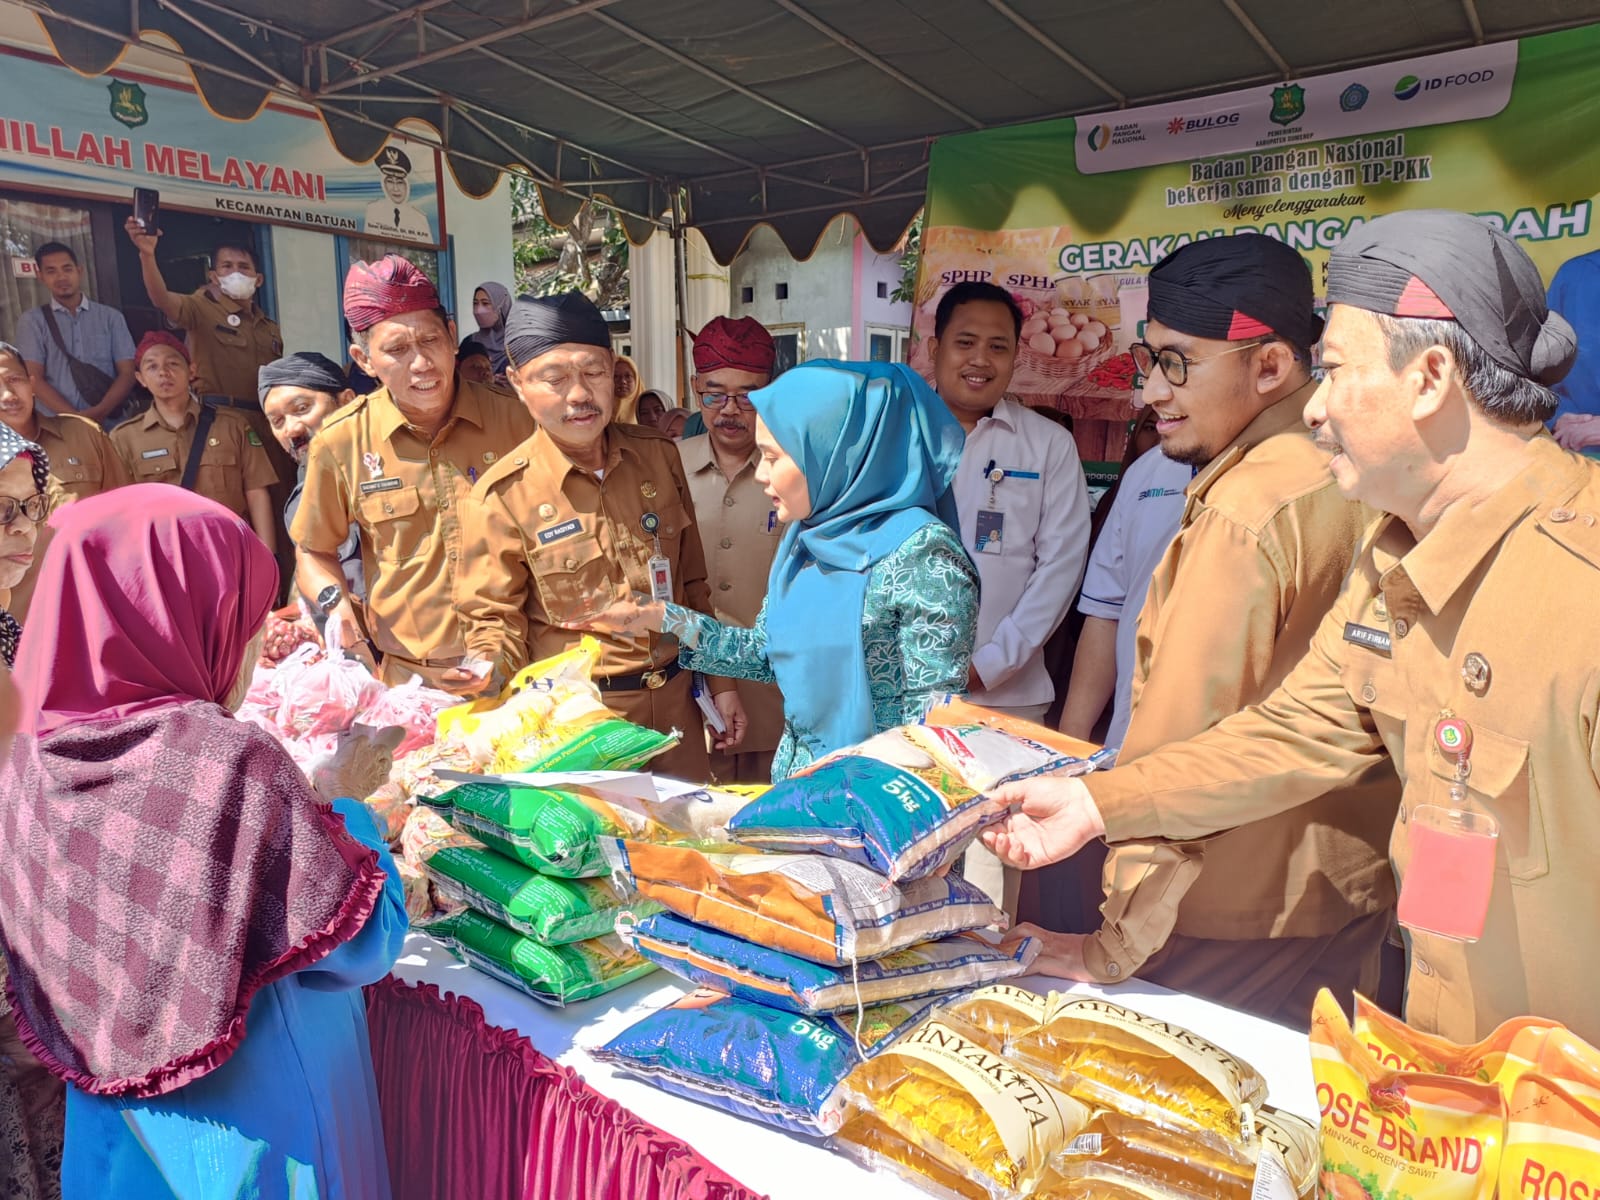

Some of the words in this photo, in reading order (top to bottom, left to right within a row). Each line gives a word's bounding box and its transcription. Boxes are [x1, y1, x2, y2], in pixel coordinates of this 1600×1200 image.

[1424, 79, 1443, 91] ID
[1444, 69, 1494, 88] FOOD
[1112, 129, 1142, 138] PANGAN
[1114, 122, 1139, 132] BADAN
[1186, 112, 1240, 130] BULOG
[1111, 135, 1147, 145] NASIONAL
[0, 118, 133, 169] ILLAH
[144, 143, 327, 202] MELAYANI
[1191, 159, 1245, 182] Badan
[1251, 149, 1318, 174] Pangan
[1325, 135, 1403, 165] Nasional
[1166, 182, 1230, 206] bekerja
[1237, 177, 1282, 197] sama
[1288, 167, 1355, 190] dengan
[1361, 157, 1431, 184] TP-PKK
[215, 197, 301, 221] KECAMATAN
[305, 212, 357, 230] BATUAN
[1222, 193, 1367, 221] Menyelenggarakan
[1059, 230, 1225, 272] GERAK
[941, 270, 992, 284] SPHP
[1006, 274, 1056, 289] SPH
[881, 779, 906, 795] 5
[897, 790, 921, 813] kg
[790, 1019, 816, 1035] 5
[808, 1028, 837, 1050] kg
[1323, 1125, 1360, 1151] MINYAK
[1361, 1145, 1407, 1172] GORENG
[1407, 1165, 1438, 1180] SAWIT
[1377, 1115, 1483, 1176] BRAND
[1520, 1157, 1600, 1200] ROS
